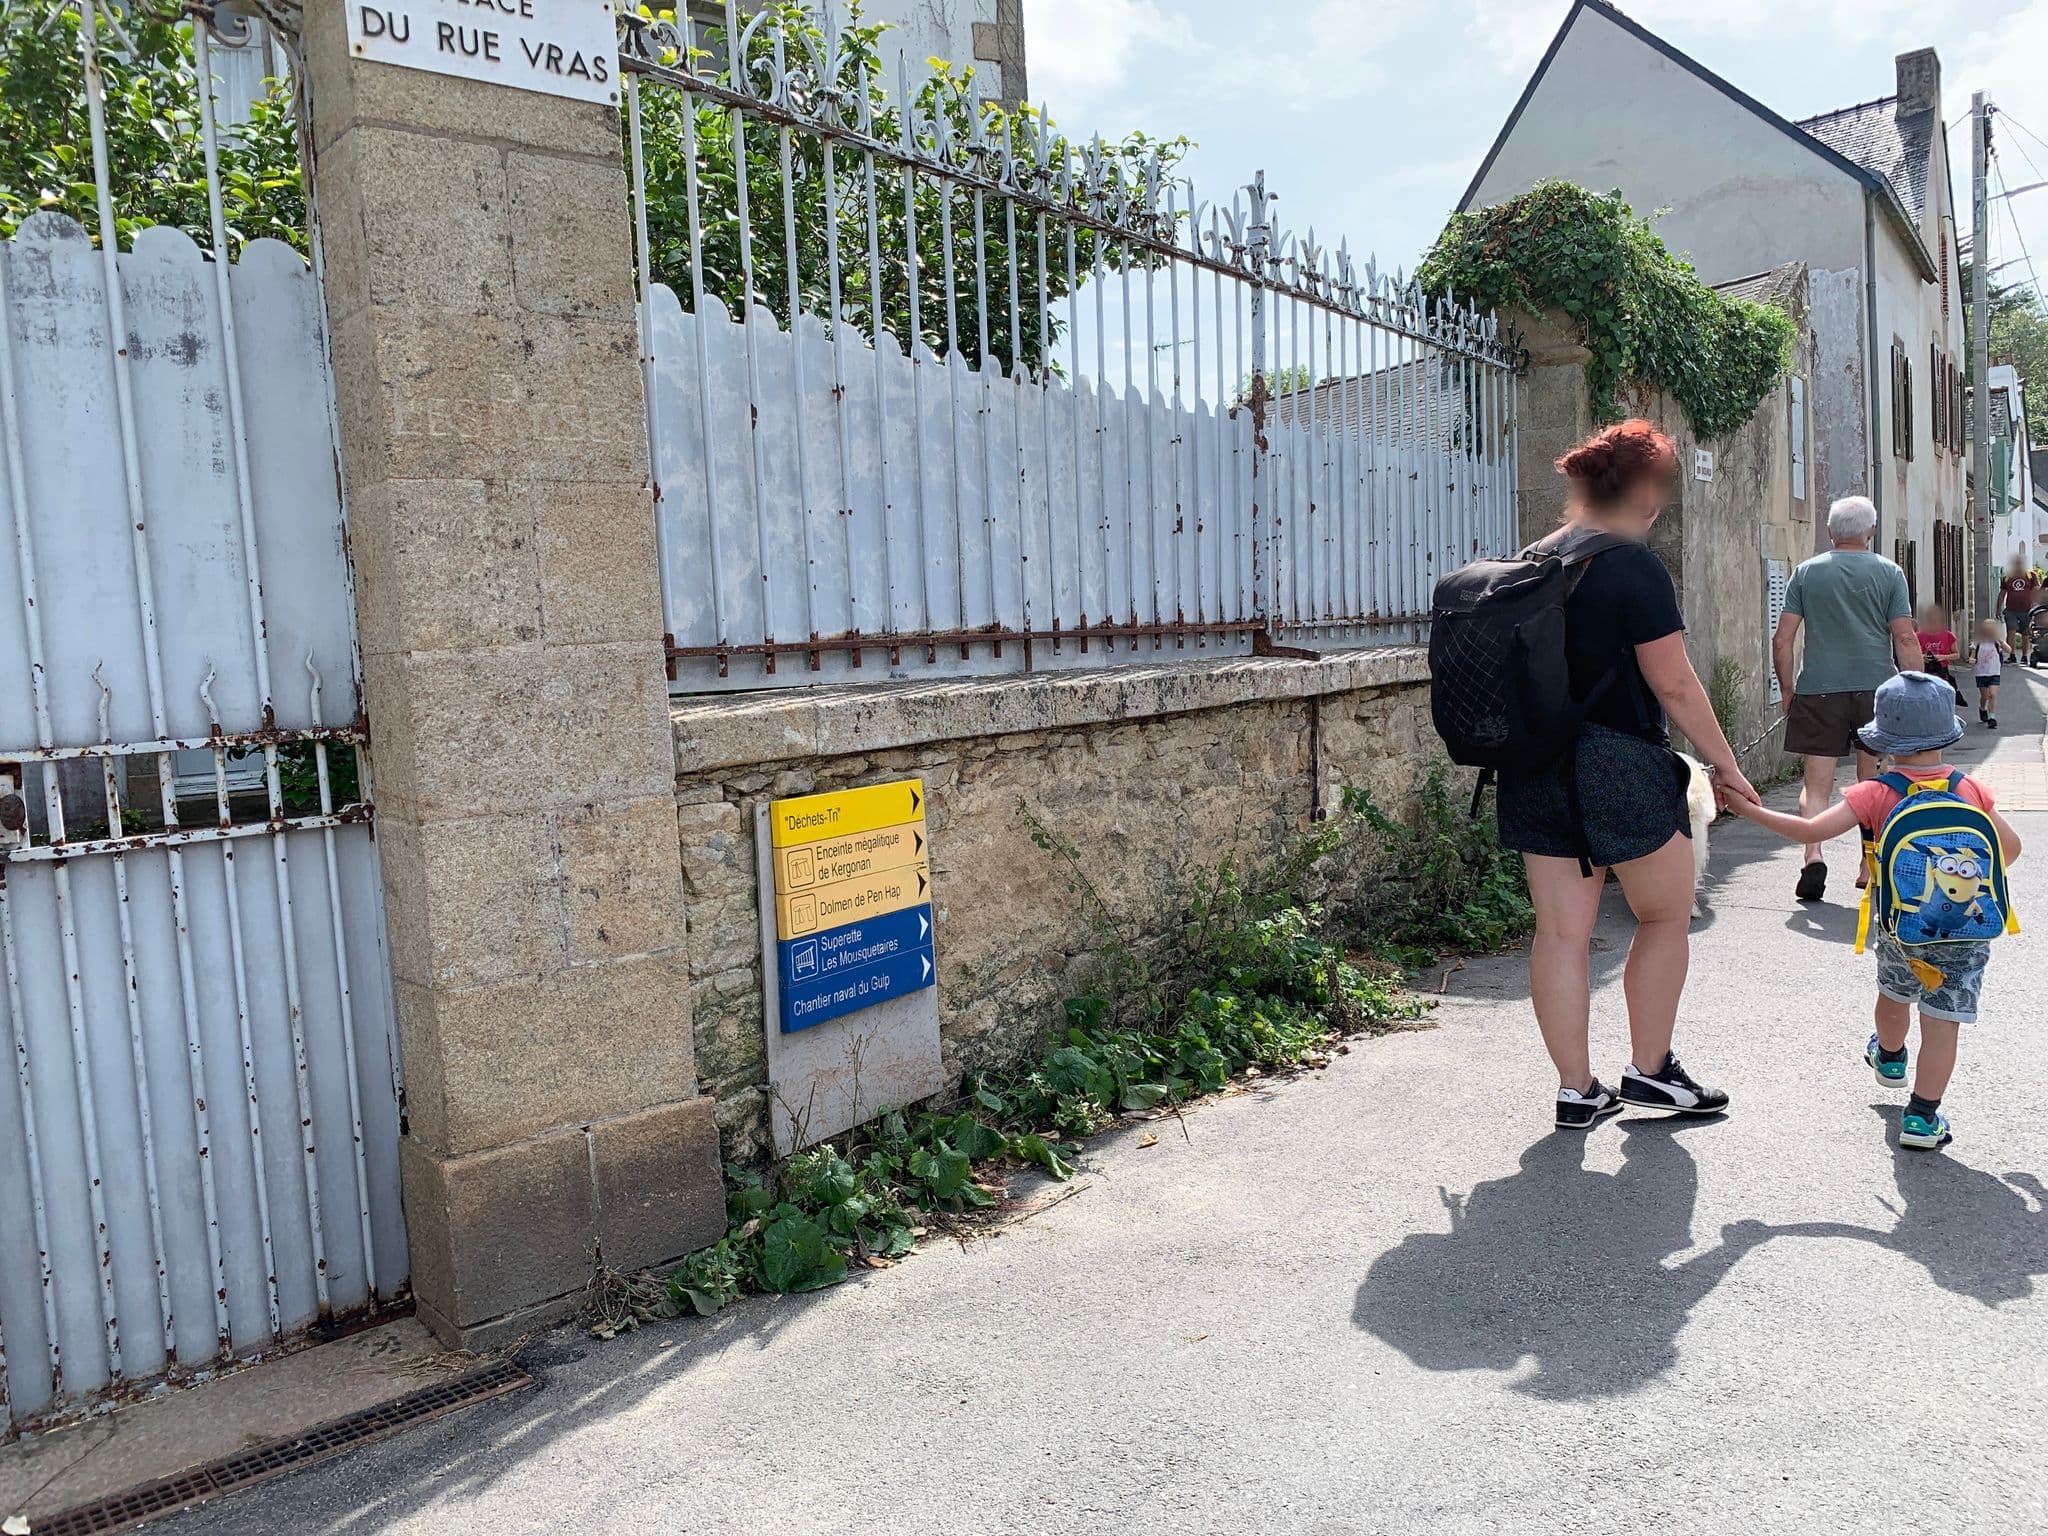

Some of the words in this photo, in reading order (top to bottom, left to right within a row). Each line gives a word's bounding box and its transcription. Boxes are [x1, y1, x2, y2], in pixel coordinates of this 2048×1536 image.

[360, 6, 410, 42] DU
[437, 21, 501, 62] RUE
[520, 37, 608, 82] VRAS
[816, 840, 853, 861] Enceinte
[818, 865, 830, 880] de
[831, 858, 871, 877] Kergonan
[820, 898, 852, 916] Dolmen
[854, 894, 865, 907] de
[867, 889, 883, 903] Pen
[885, 885, 901, 899] Hap
[821, 929, 862, 951] Superette
[821, 957, 838, 972] Les
[839, 938, 899, 966] Mousquetaires
[793, 994, 831, 1017] Chantier
[833, 981, 857, 1004] naval
[858, 979, 869, 995] du
[870, 974, 890, 992] Guip
